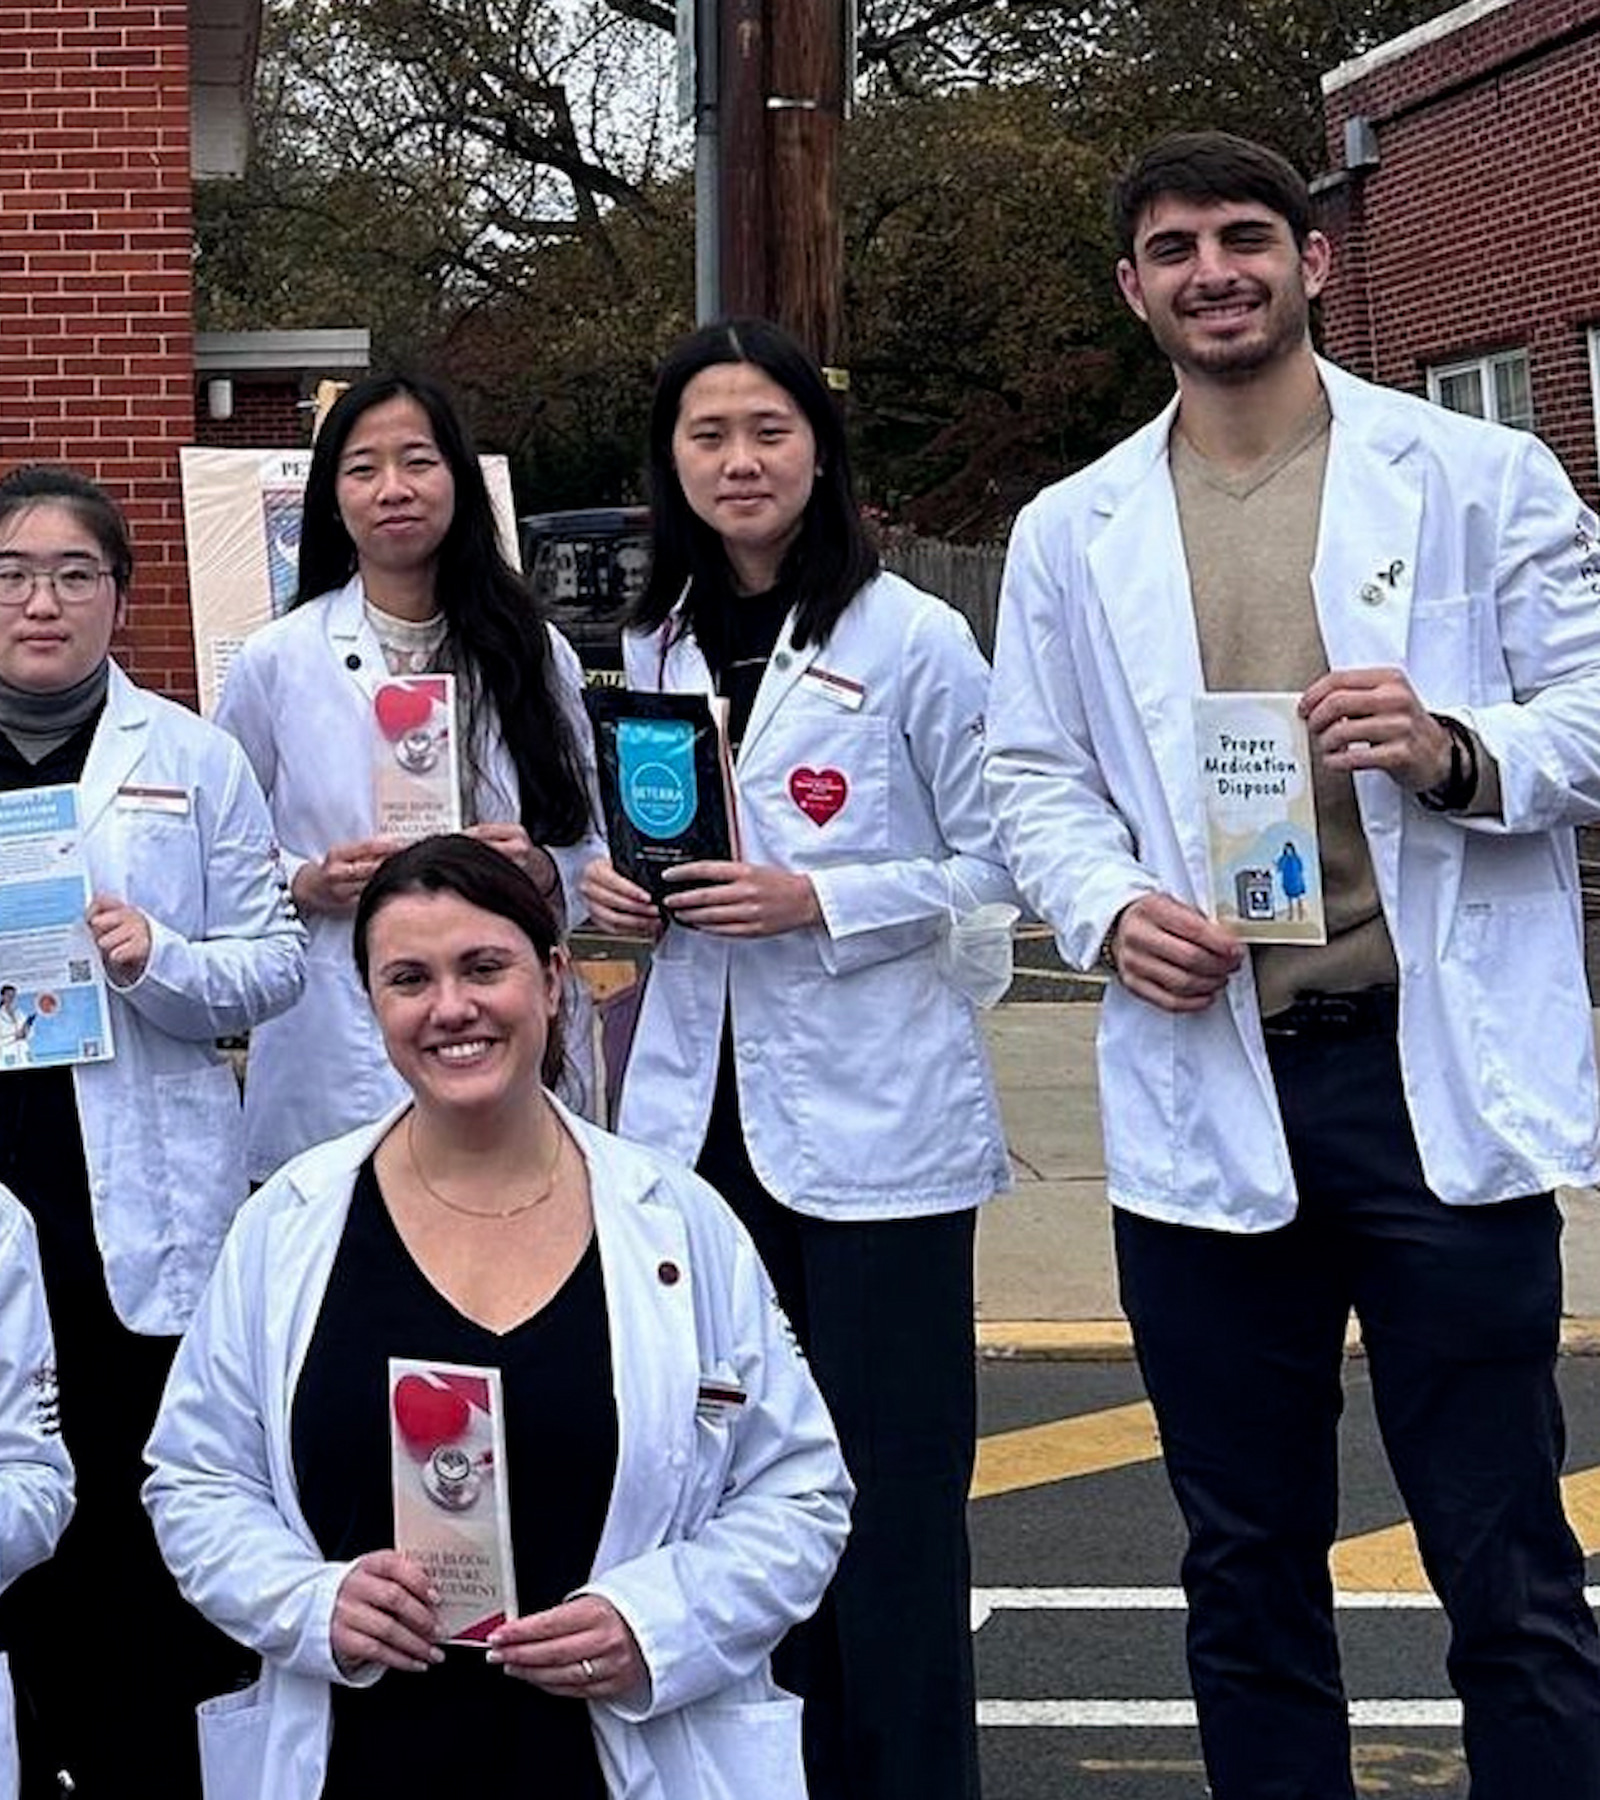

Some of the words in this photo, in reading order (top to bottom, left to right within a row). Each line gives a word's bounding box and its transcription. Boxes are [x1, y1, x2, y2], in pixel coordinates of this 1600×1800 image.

[1219, 734, 1276, 753] Proper
[1203, 756, 1297, 774] Medication
[1216, 777, 1287, 800] Disposal
